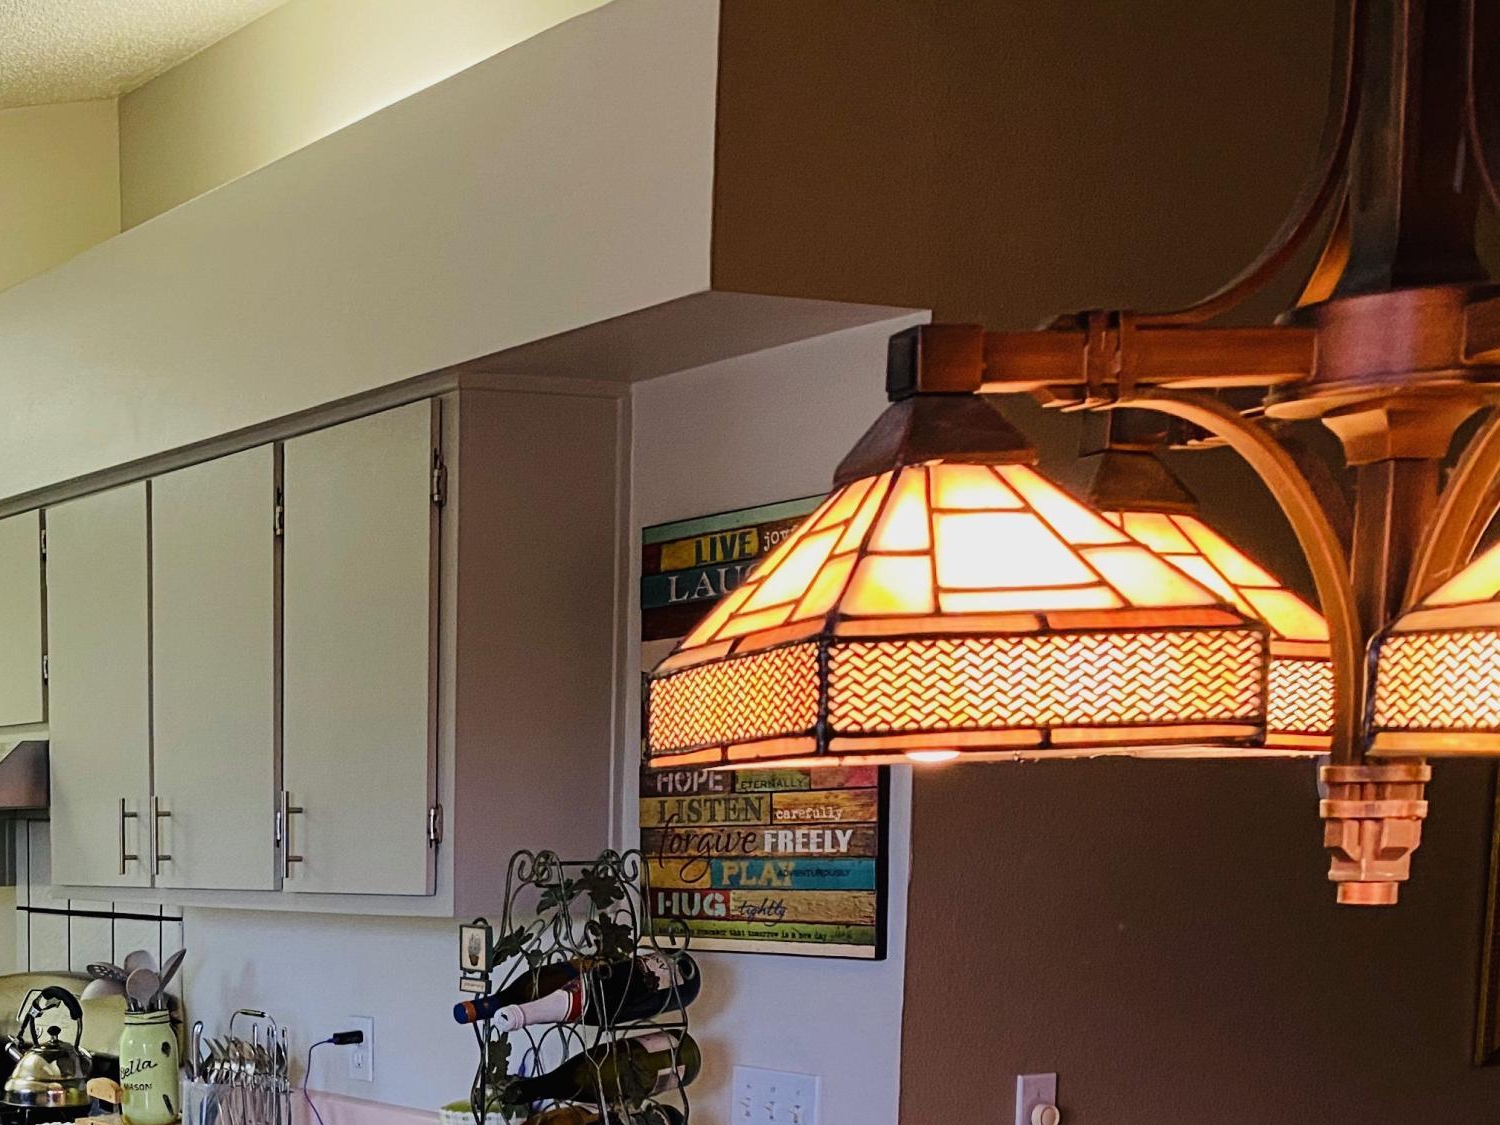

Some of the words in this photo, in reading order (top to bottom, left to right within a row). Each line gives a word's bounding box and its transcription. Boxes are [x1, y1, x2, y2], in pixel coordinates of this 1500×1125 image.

[694, 530, 754, 564] LIVE
[656, 771, 724, 793] HOPE
[740, 779, 805, 789] ETERNALLY
[658, 797, 764, 824] LISTEN
[776, 806, 844, 822] carefully
[659, 813, 759, 883] forgive
[764, 829, 854, 853] FREELY
[721, 860, 795, 886] PLAY
[657, 892, 727, 917] HUG
[737, 897, 788, 927] tightly
